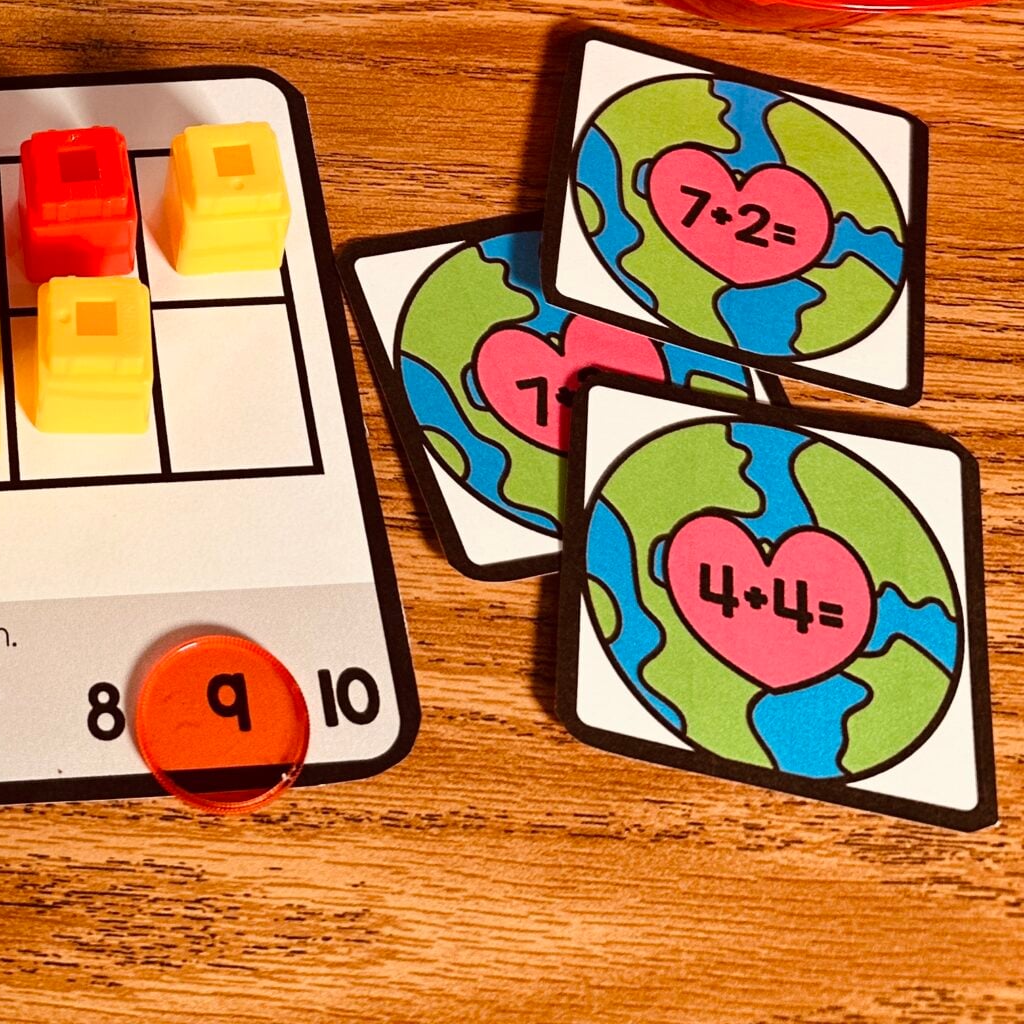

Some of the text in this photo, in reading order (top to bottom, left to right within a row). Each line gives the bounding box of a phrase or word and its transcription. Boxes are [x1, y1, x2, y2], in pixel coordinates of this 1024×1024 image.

[678, 183, 797, 250] 7+2=
[699, 561, 844, 634] 4+4=
[86, 682, 126, 741] 8
[206, 672, 251, 732] 9
[318, 667, 380, 728] 10
